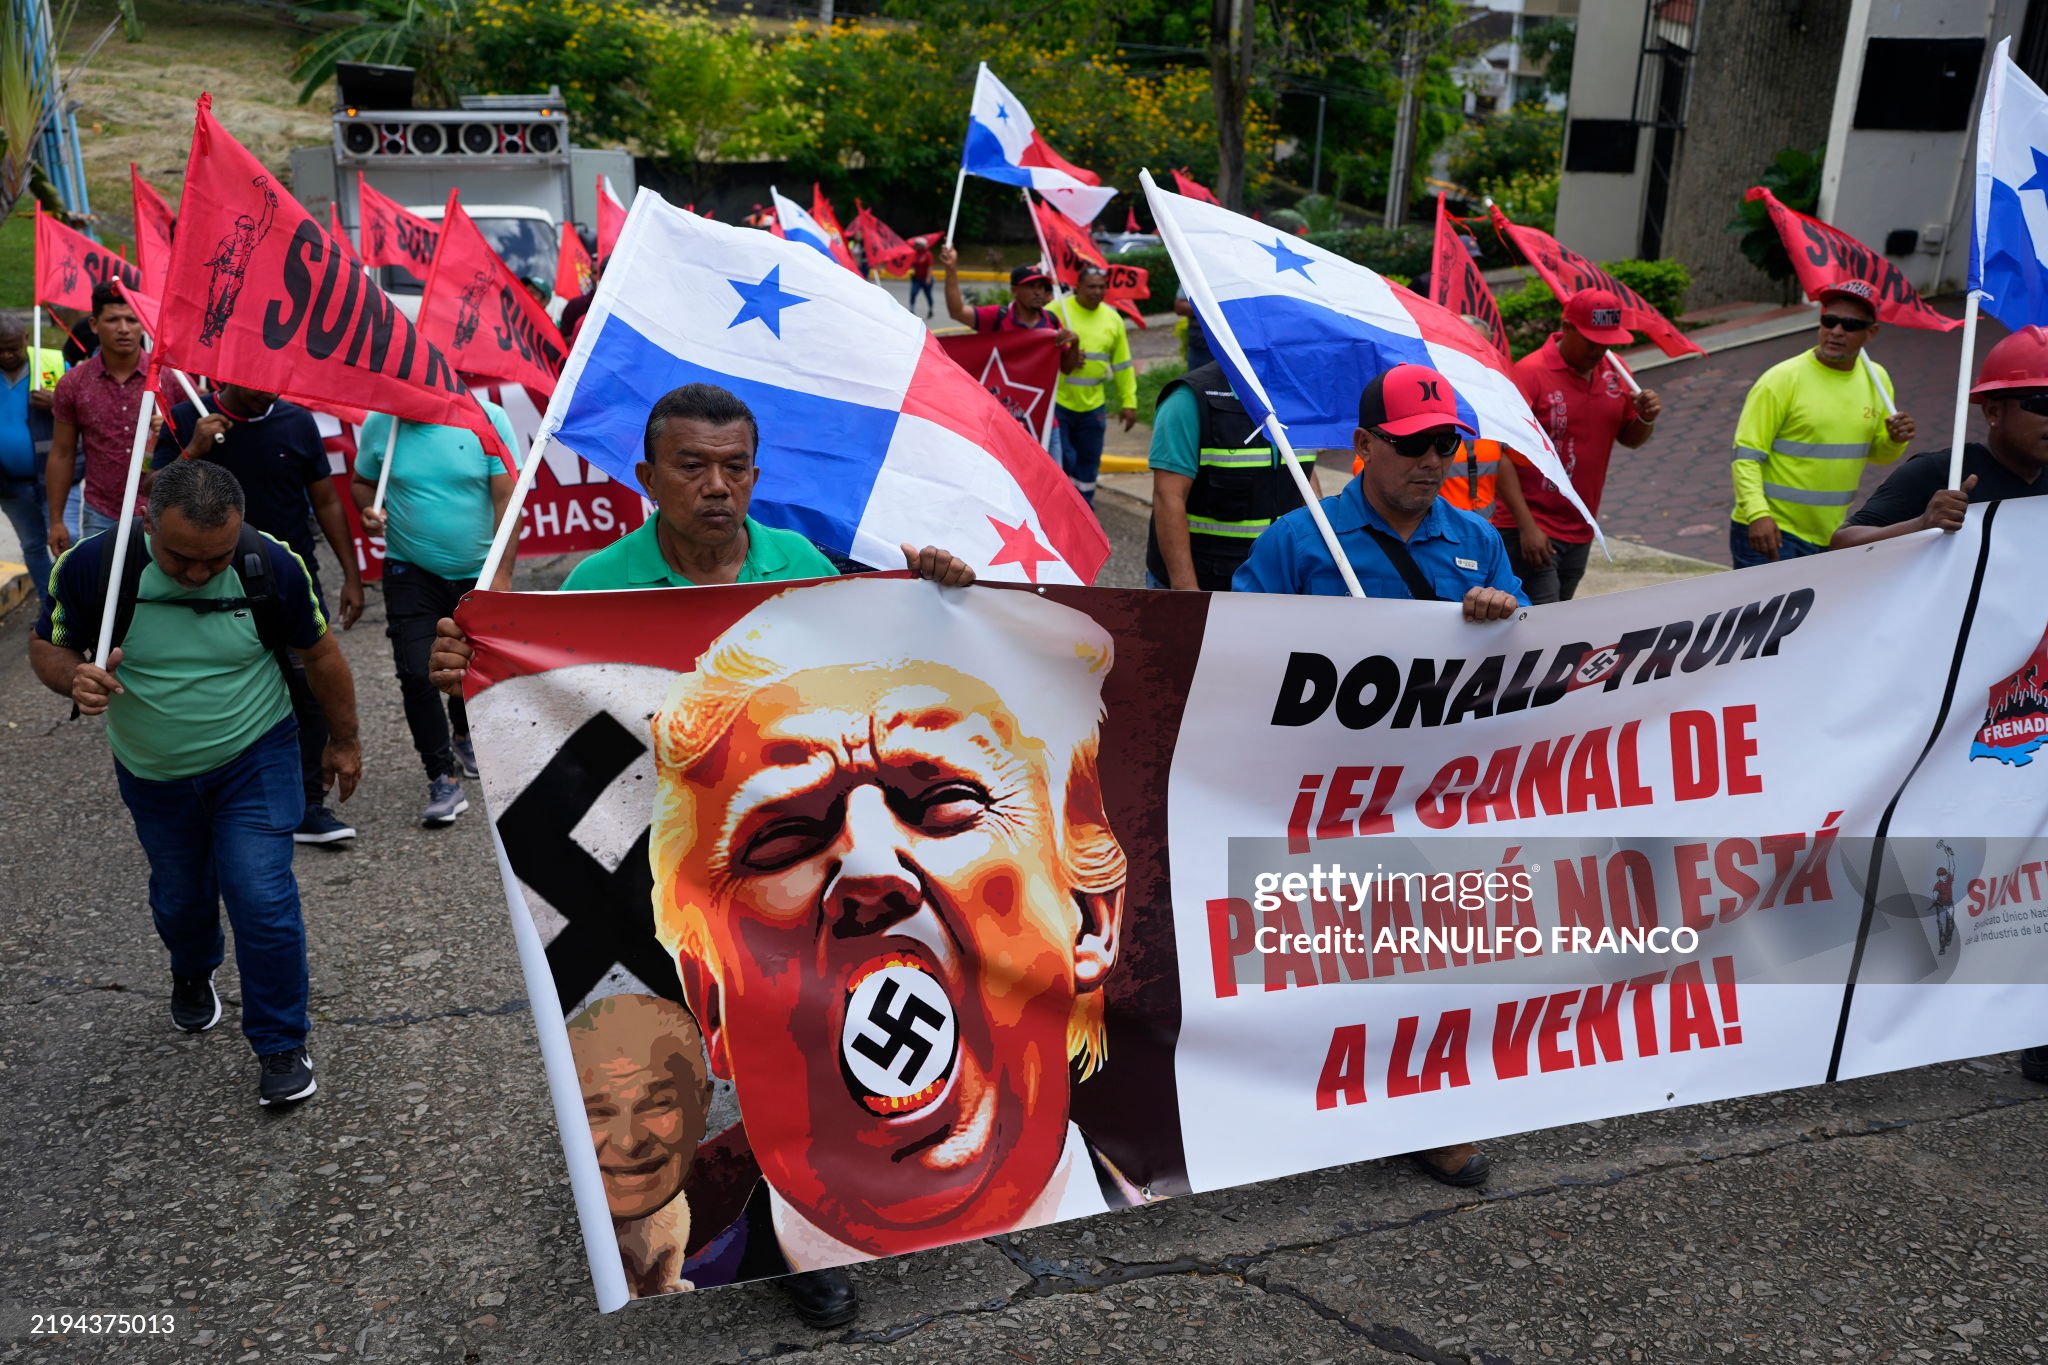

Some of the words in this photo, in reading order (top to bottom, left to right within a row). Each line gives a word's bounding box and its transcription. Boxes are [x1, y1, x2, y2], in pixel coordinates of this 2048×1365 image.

[1271, 641, 1594, 730] DONALD
[1602, 588, 1815, 693] TRUMP
[1983, 717, 2048, 743] FRENAD
[1287, 766, 1405, 855] ¡EL
[1415, 719, 1654, 830] CANAL
[1669, 704, 1763, 802] DE
[1206, 845, 1544, 999] PANAMÁ
[1554, 849, 1659, 953] NO
[1673, 810, 1844, 936] ESTÁ
[1967, 860, 2048, 918] SUNT
[1315, 1023, 1367, 1111] A
[1386, 1008, 1470, 1099] LA
[1490, 955, 1744, 1081] VENTA!
